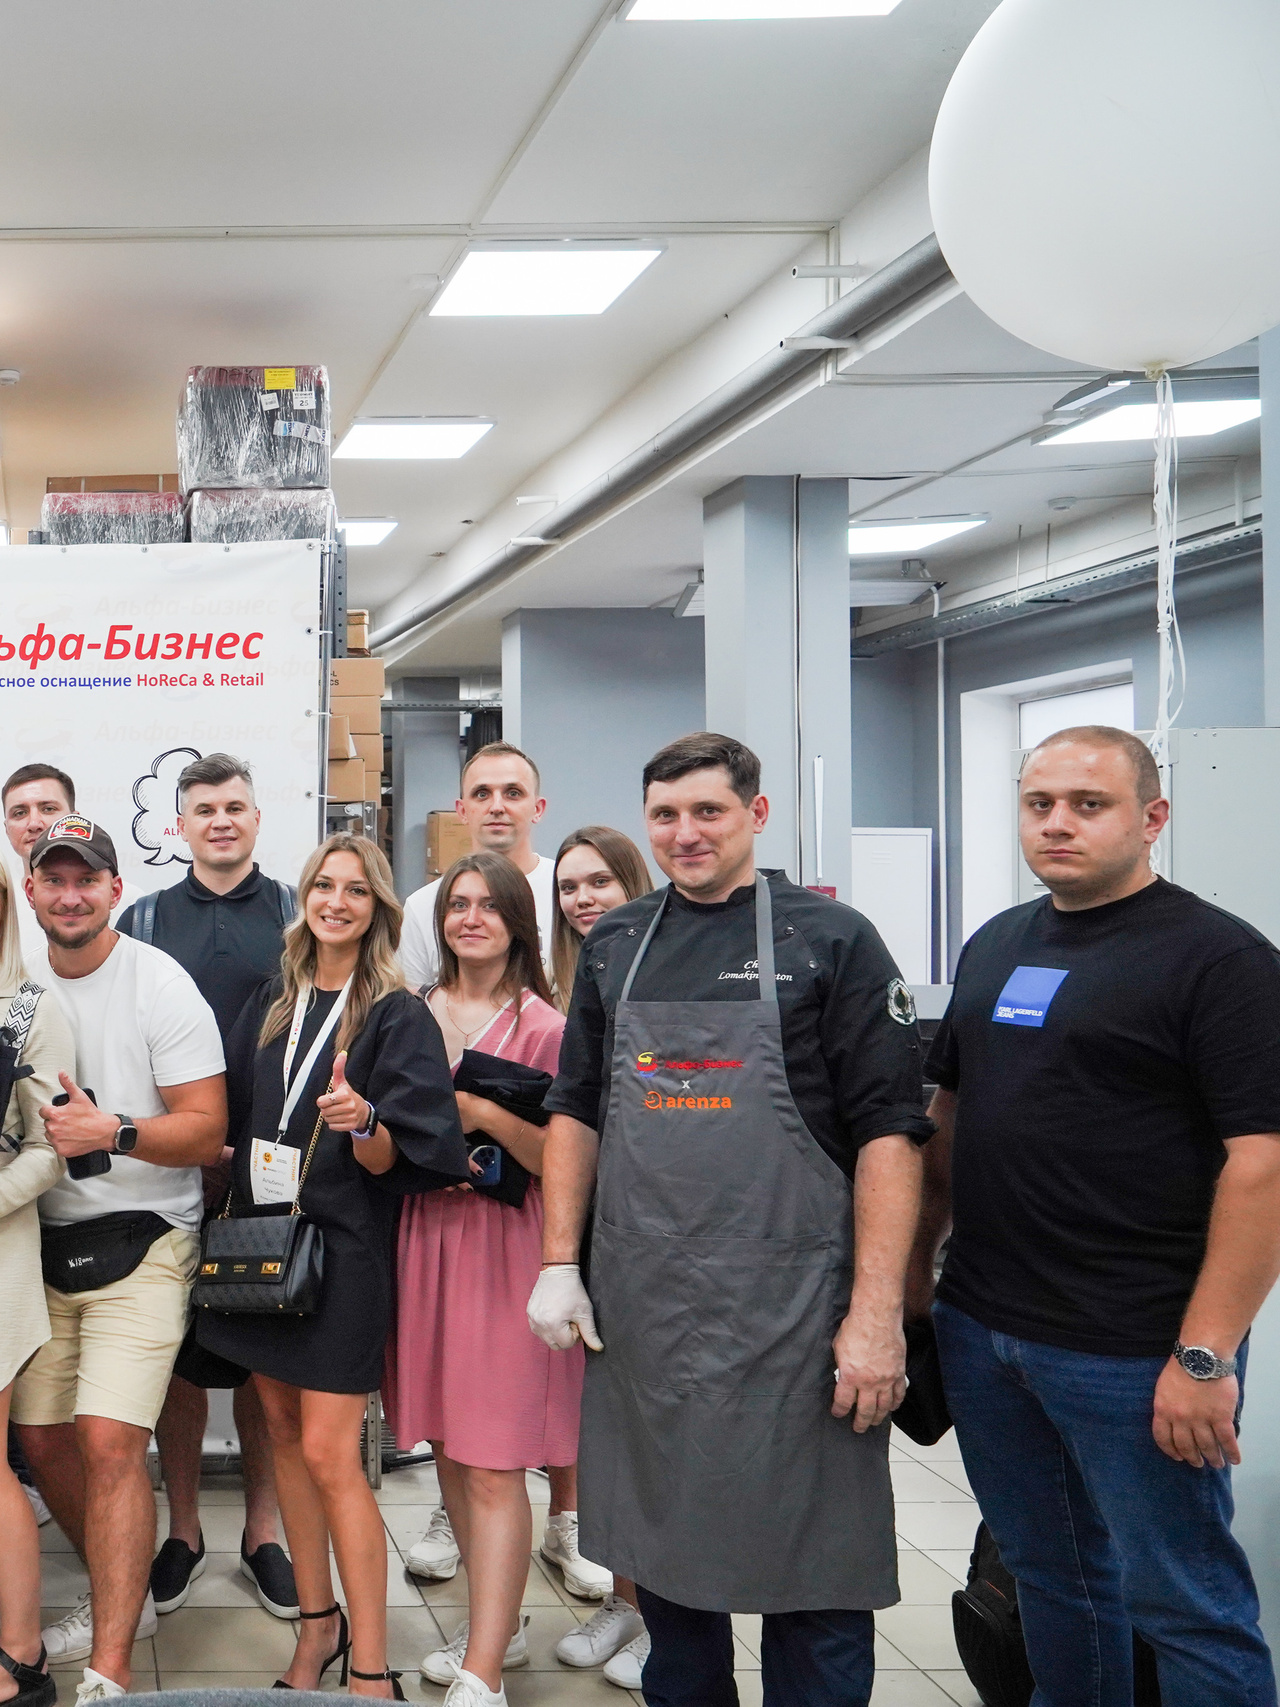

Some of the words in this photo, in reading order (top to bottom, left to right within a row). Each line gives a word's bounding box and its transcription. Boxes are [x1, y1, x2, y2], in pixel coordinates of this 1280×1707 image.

[40, 676, 132, 690] оснащение
[137, 673, 197, 687] HoReCa
[202, 673, 215, 687] &
[220, 672, 264, 686] Retail
[743, 959, 759, 970] Ch
[717, 970, 760, 981] Lomakin
[1012, 1008, 1044, 1017] LAGERFELD
[666, 1096, 732, 1109] arenza
